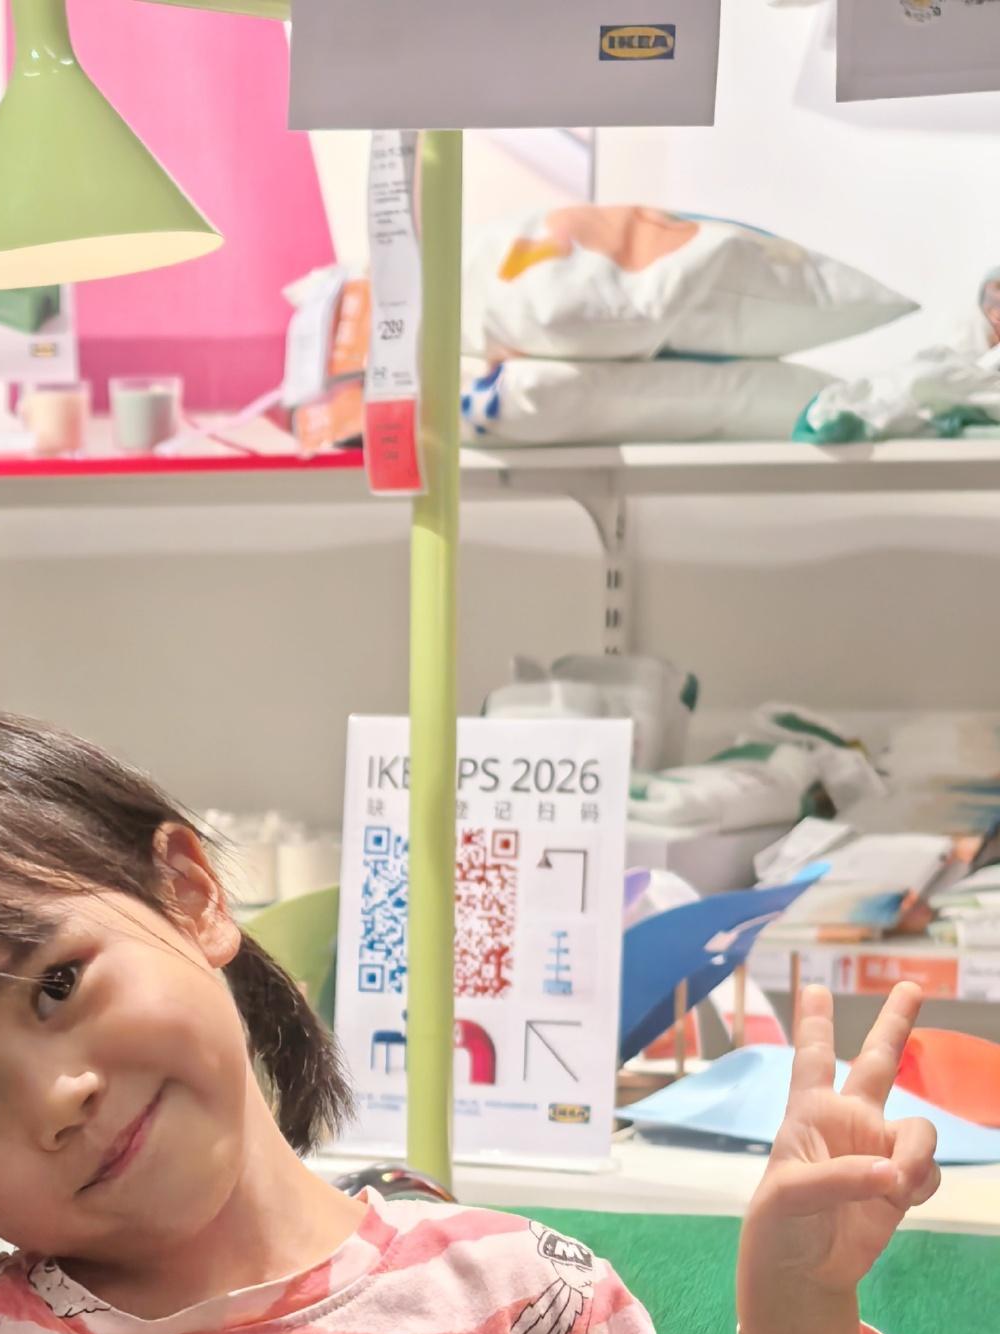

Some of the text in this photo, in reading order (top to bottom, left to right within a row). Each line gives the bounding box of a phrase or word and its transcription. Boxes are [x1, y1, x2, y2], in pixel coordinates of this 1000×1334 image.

[607, 34, 669, 49] IKEA
[367, 755, 601, 795] IKE PS 2026
